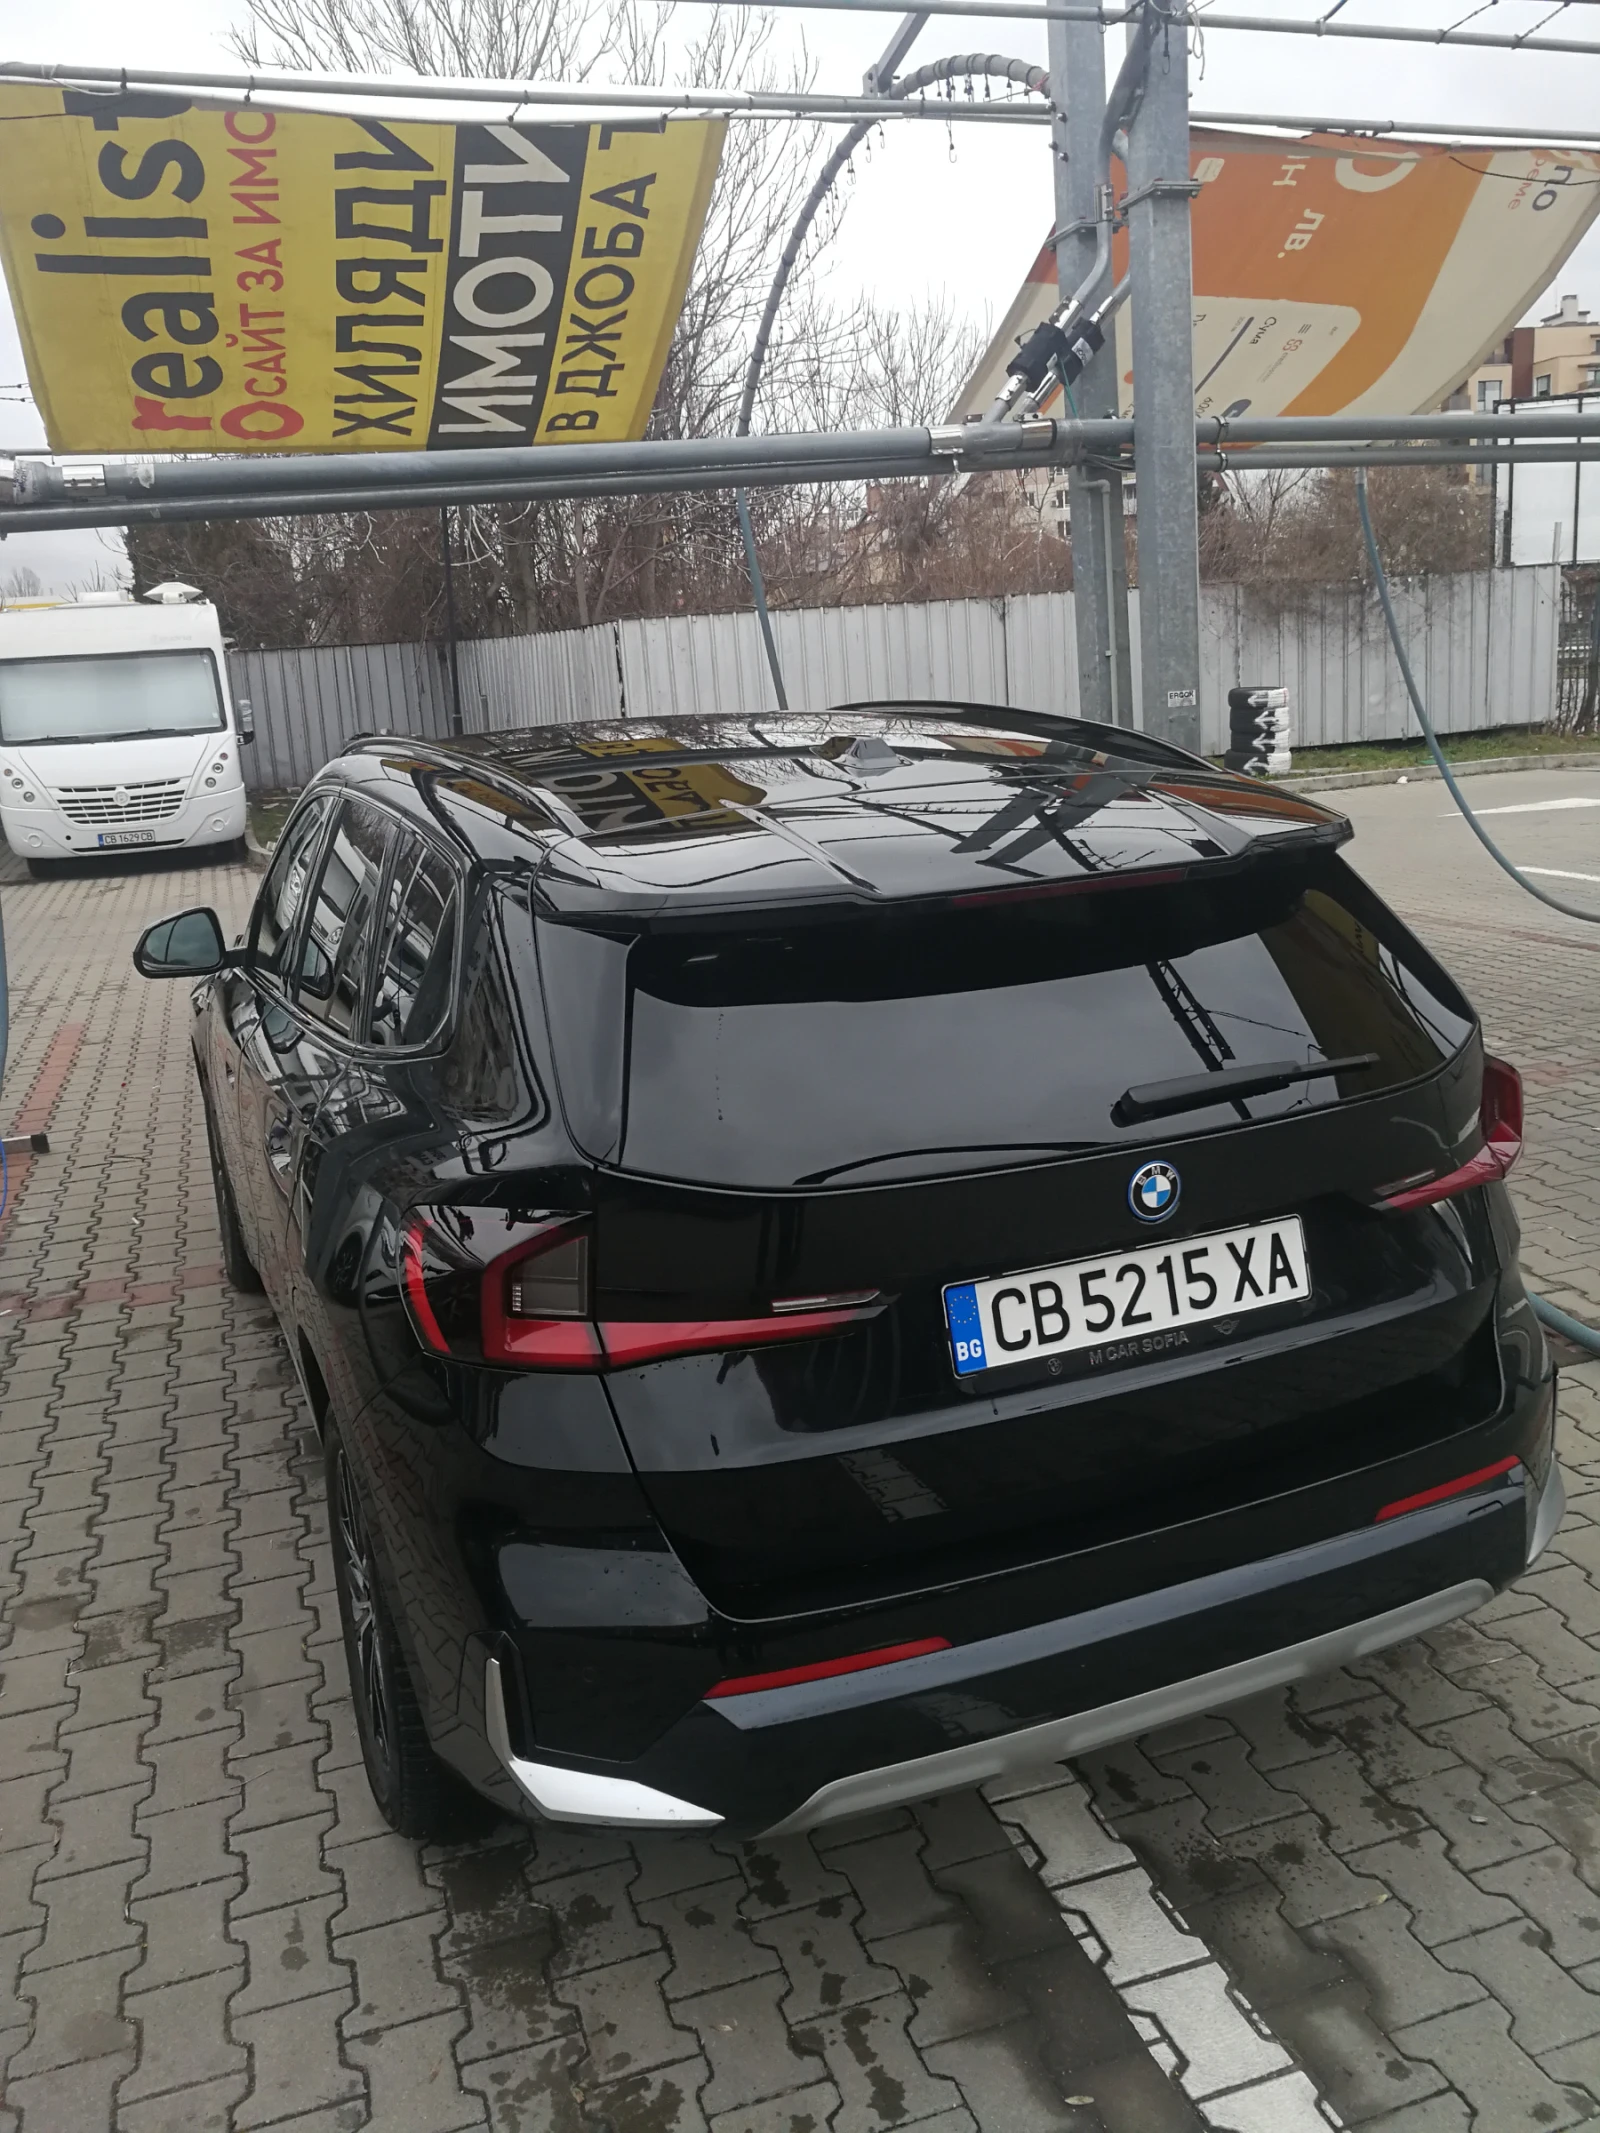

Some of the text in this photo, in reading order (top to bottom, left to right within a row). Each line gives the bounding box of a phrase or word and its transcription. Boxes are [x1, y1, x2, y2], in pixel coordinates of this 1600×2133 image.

[237, 239, 284, 292] ЗА
[554, 172, 658, 399] ДЖОБА
[119, 833, 140, 843] 1629
[1135, 1165, 1177, 1186] BMW
[1079, 1247, 1218, 1332] 5215
[955, 1337, 983, 1362] BG
[1088, 1330, 1190, 1366] M CAR SOFIA
